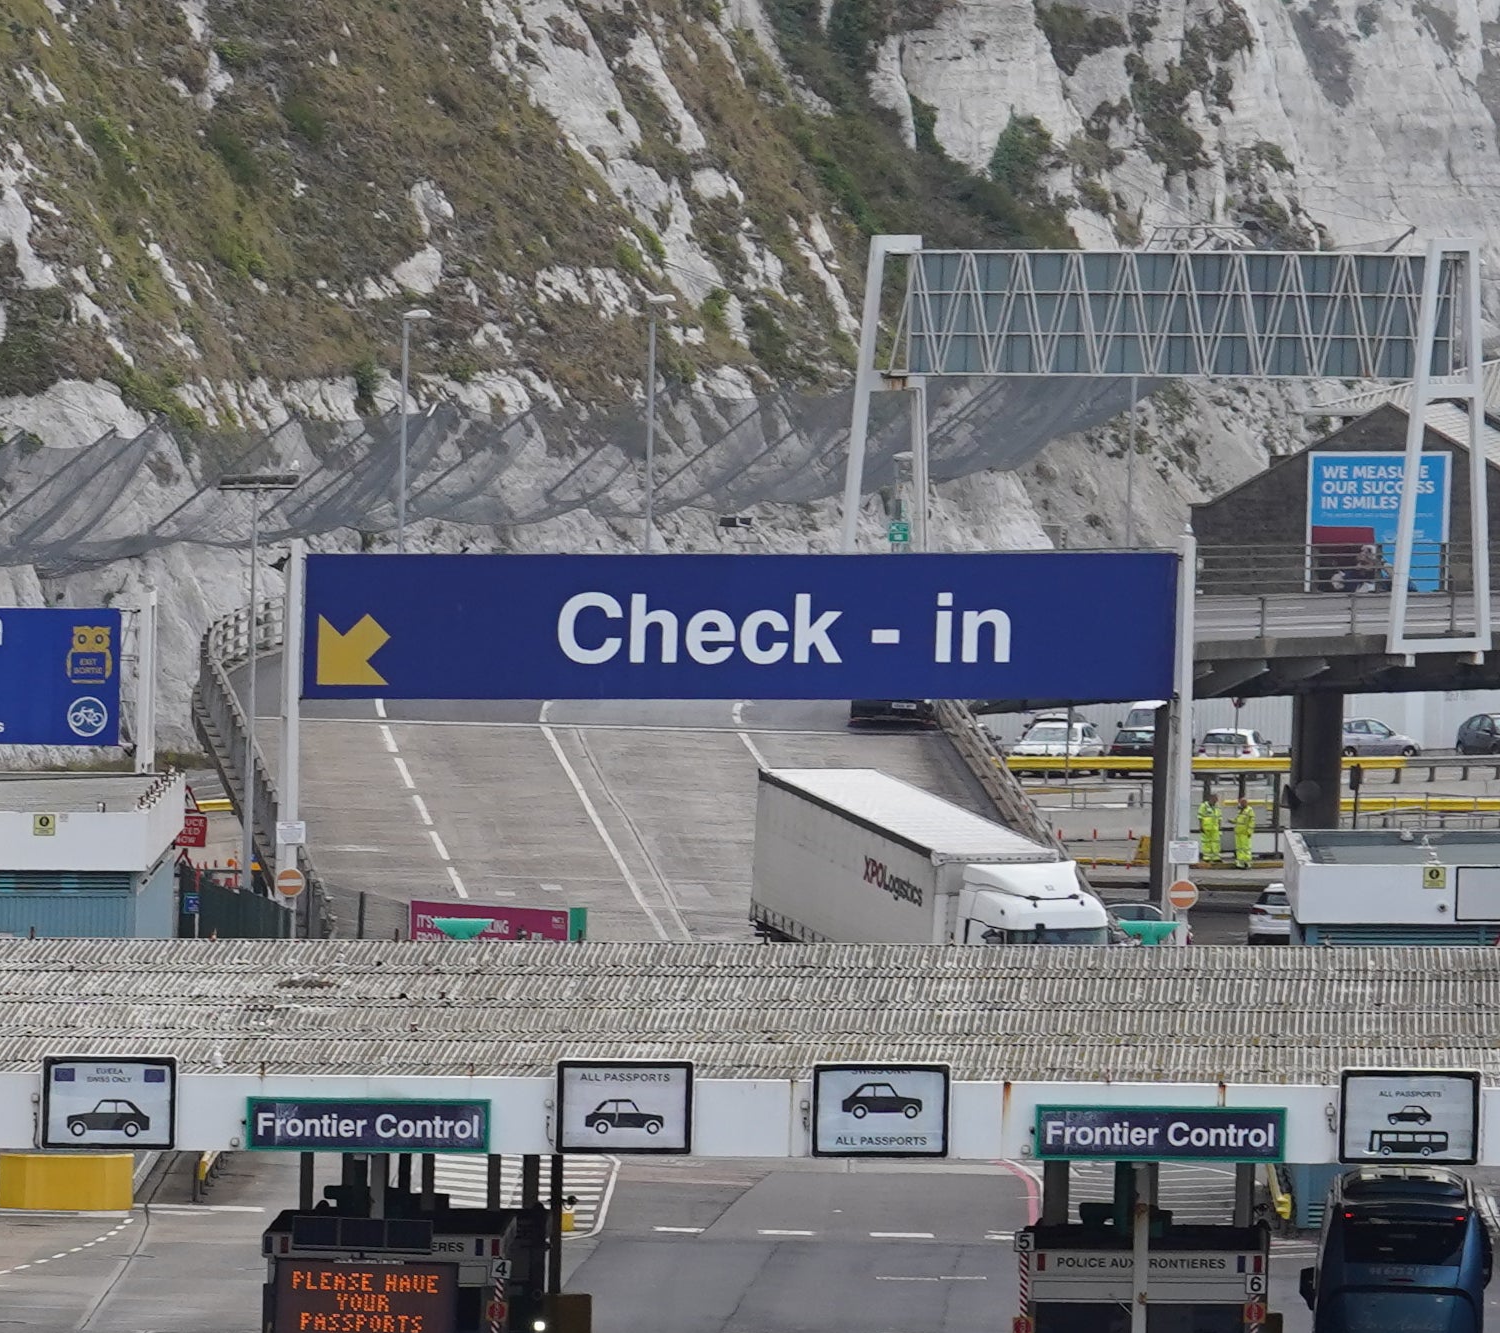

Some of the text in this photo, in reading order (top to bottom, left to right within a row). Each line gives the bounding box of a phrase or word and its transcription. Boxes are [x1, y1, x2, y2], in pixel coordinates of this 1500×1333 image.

[1322, 465, 1429, 479] WE MEASUE
[1322, 482, 1435, 495] OUR SUCCSS
[1321, 497, 1398, 509] IN SMILES
[557, 590, 844, 664] Check
[934, 591, 1014, 663] in
[580, 1072, 671, 1083] ALL PASSPORTS
[1378, 1090, 1442, 1098] ALL PASSPORTS
[256, 1111, 480, 1139] Frontier Control
[835, 1136, 928, 1146] ALL PASSPORTS
[1045, 1121, 1276, 1148] Frontier Control
[1018, 1234, 1029, 1250] 5
[494, 1261, 507, 1275] 4
[1056, 1256, 1107, 1270] POLICE
[1146, 1257, 1227, 1271] RONTIERES
[292, 1271, 439, 1294] PLEASE HAVE
[1249, 1276, 1262, 1291] 6
[336, 1293, 390, 1312] YOUR
[300, 1313, 423, 1333] PASSPORTS
